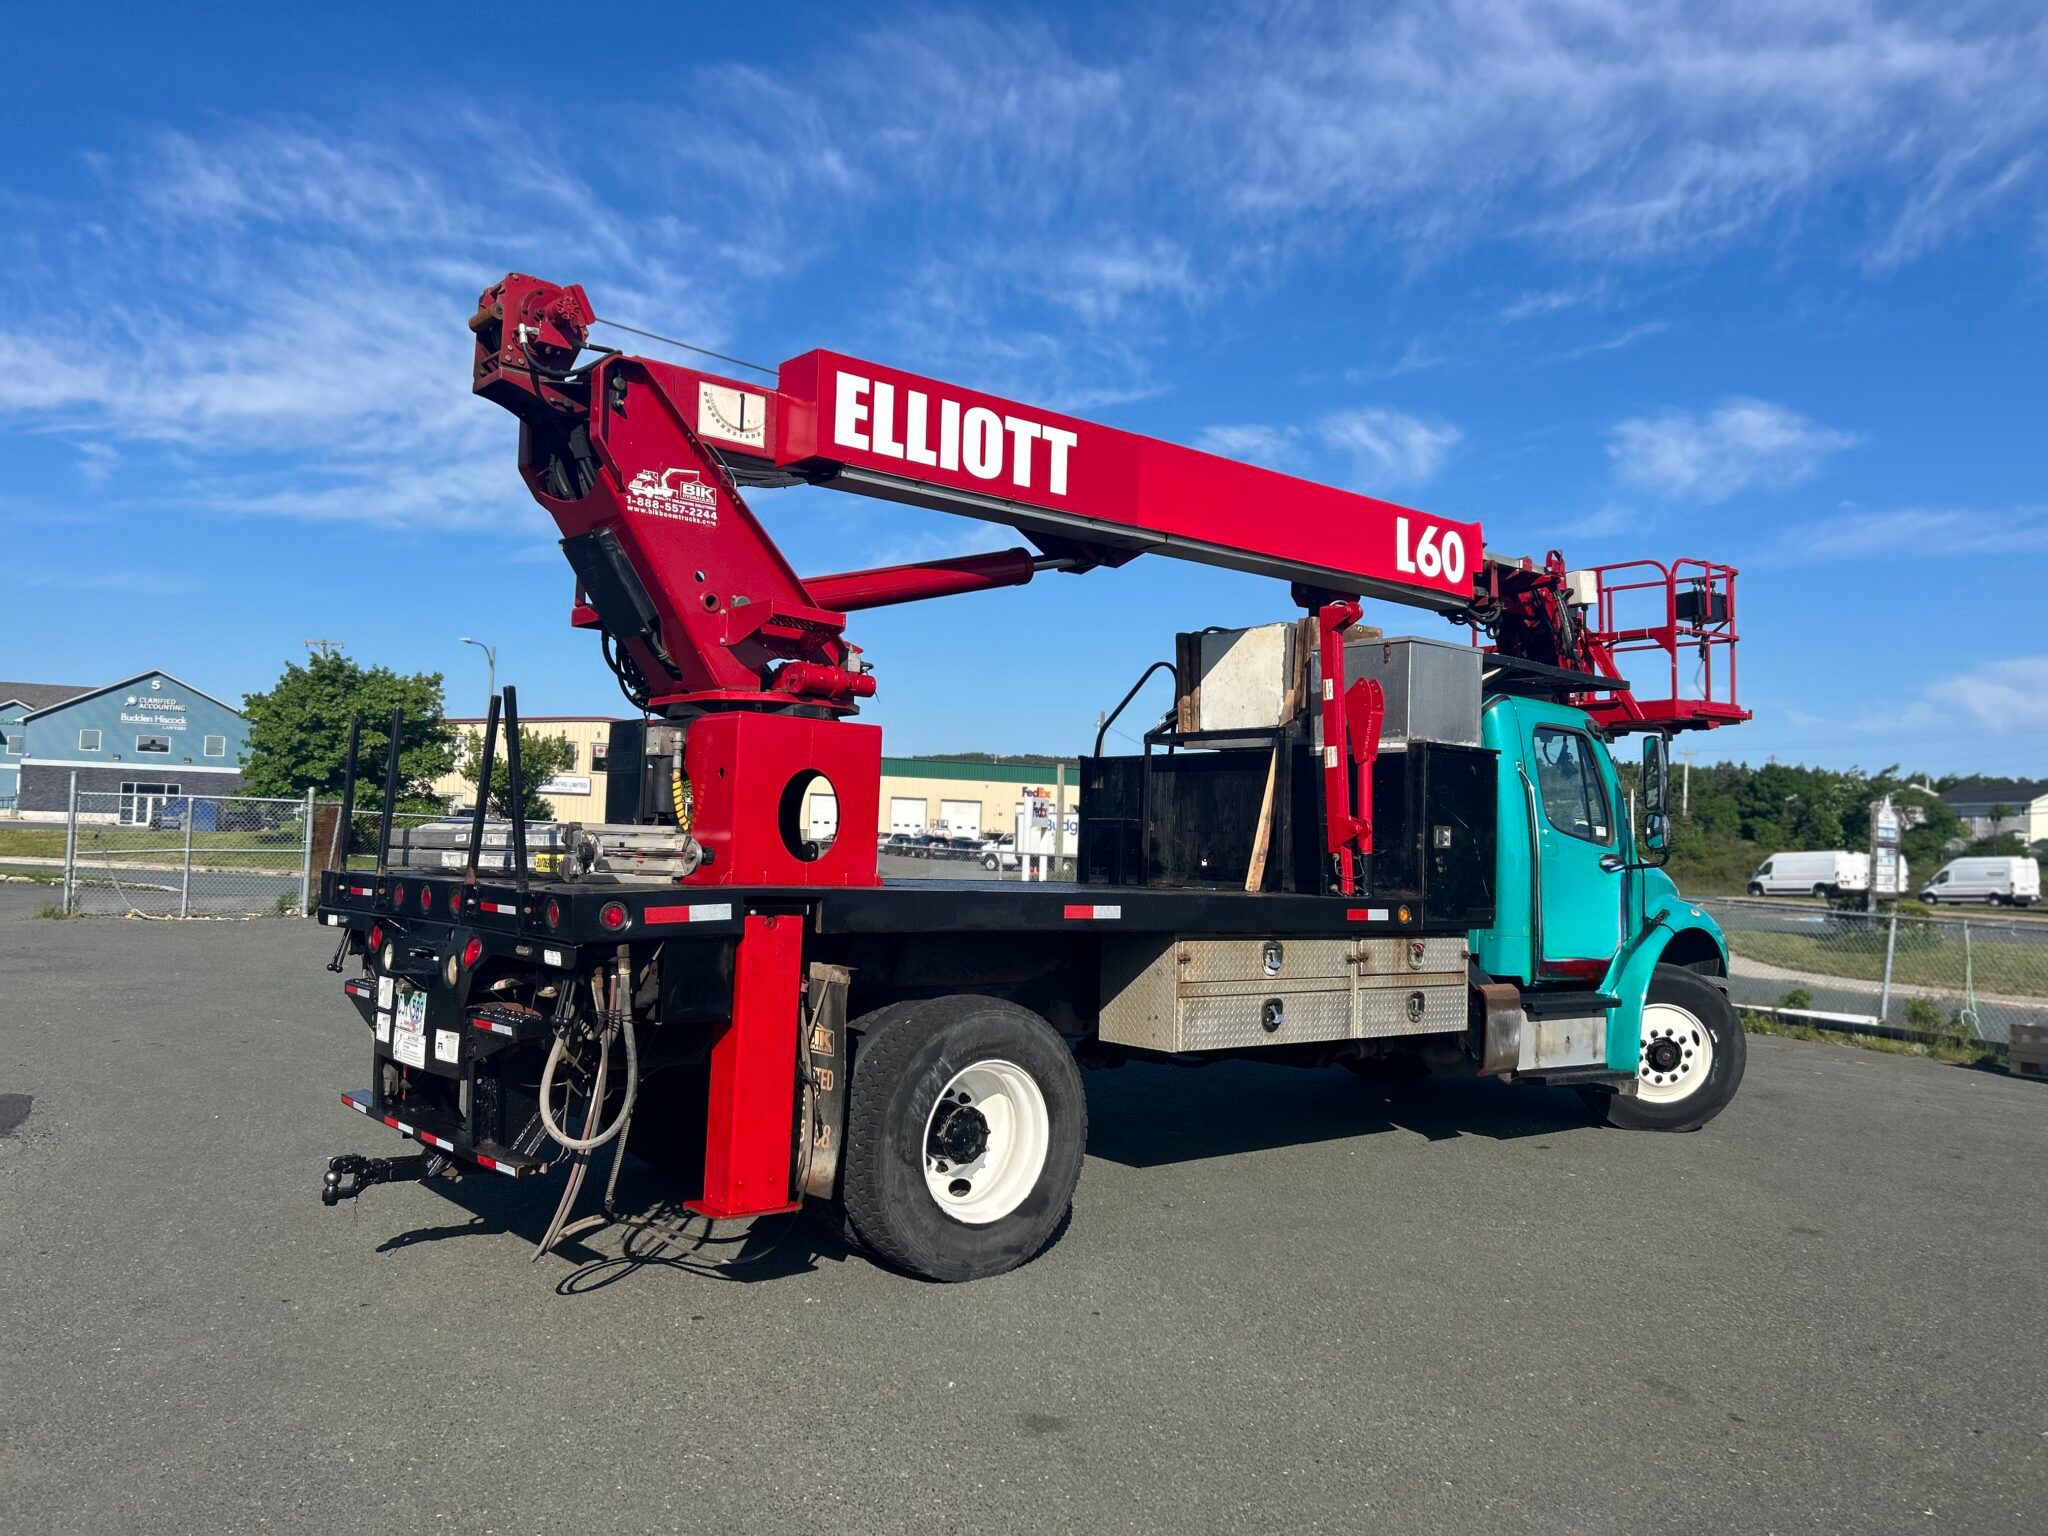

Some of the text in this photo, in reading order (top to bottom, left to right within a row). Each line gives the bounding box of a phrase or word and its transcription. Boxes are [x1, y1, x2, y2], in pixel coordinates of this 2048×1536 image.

[834, 370, 1078, 496] ELLIOTT
[683, 484, 713, 500] BIK
[626, 495, 718, 520] 1-888-557-2244
[1396, 516, 1465, 584] L60
[151, 680, 161, 689] 5
[139, 697, 177, 705] CLARIFIED
[138, 704, 186, 712] ACCOUNTING
[120, 713, 187, 724] Budden Hiscock
[1022, 786, 1051, 798] FedEx
